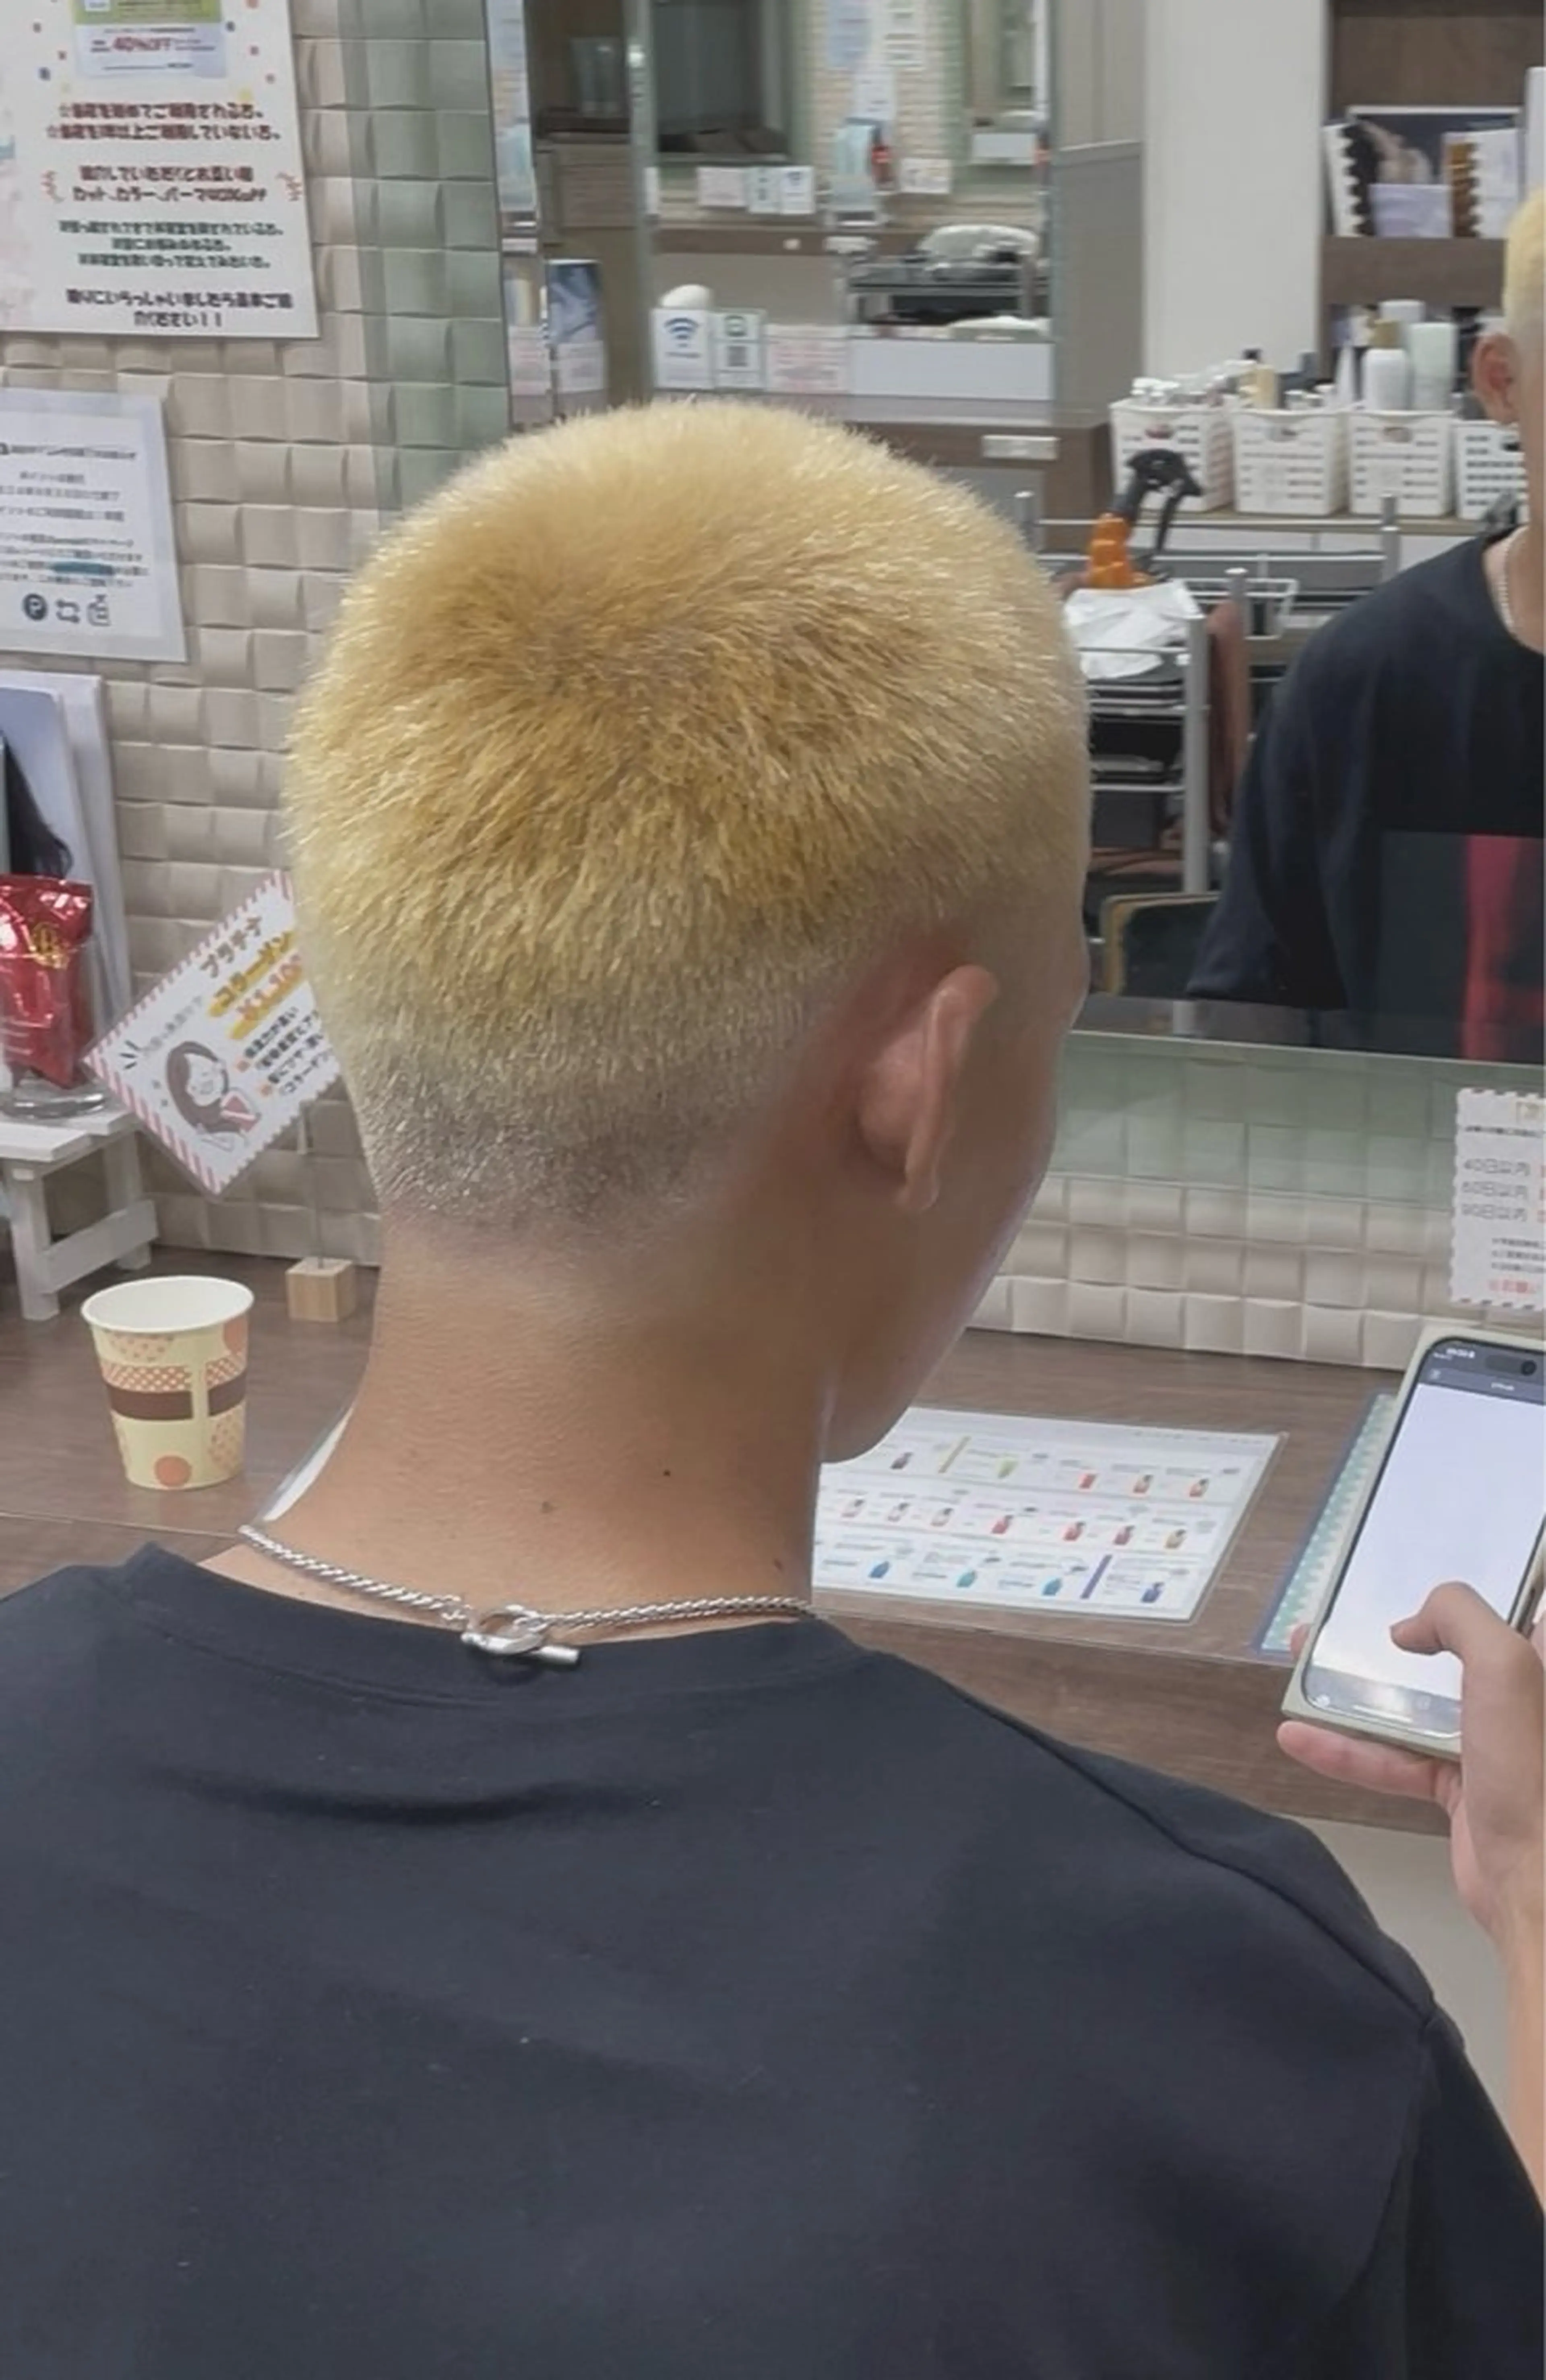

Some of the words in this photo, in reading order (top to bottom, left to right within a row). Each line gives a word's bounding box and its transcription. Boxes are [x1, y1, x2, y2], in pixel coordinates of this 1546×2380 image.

[200, 916, 262, 978] プラチナ
[214, 931, 294, 1007] コラーゲン
